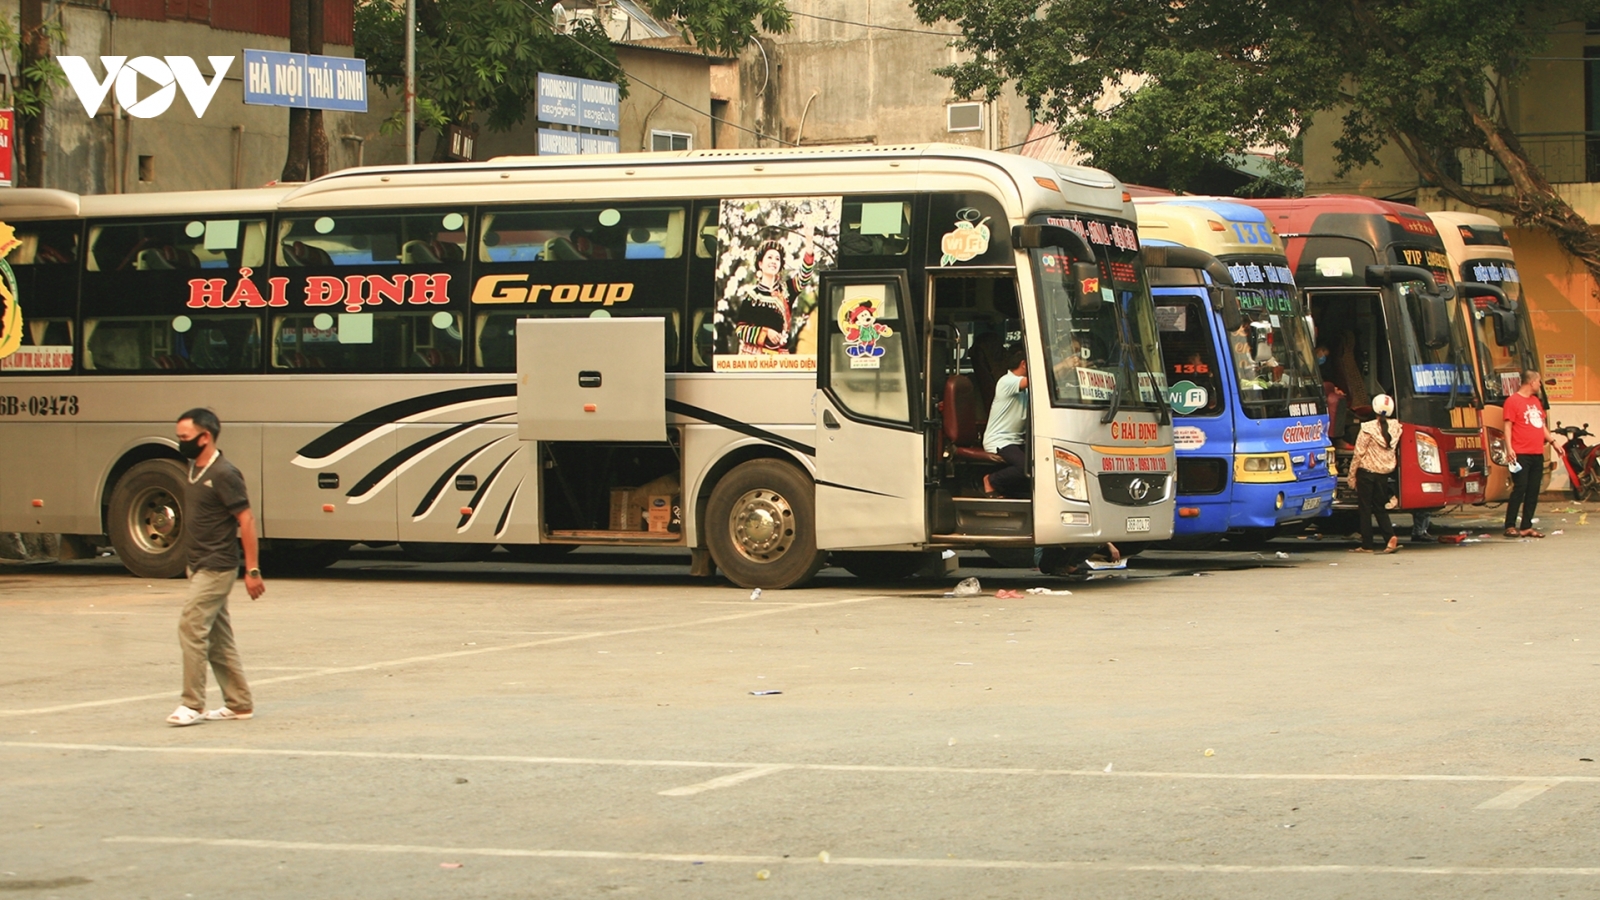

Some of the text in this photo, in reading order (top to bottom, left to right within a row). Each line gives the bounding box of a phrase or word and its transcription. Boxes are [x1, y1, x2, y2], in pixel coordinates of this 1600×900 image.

[249, 56, 302, 103] HÀ NỘI
[309, 61, 364, 101] THÁI BÌNH
[541, 78, 577, 100] PHONGSALY
[582, 84, 617, 106] OUDOMXAY
[1231, 223, 1273, 244] 136
[1402, 249, 1422, 266] VIP
[186, 267, 452, 313] HẢI ĐỊNH
[471, 273, 635, 307] Group
[1006, 330, 1021, 341] 53
[716, 360, 731, 369] HOA
[732, 360, 747, 369] BAN
[760, 355, 777, 369] KHẮP
[779, 358, 799, 369] VÙNG
[800, 358, 816, 371] ĐIỆN
[1173, 364, 1209, 374] 136
[1121, 416, 1136, 440] HẢI
[1138, 423, 1158, 445] ĐỊNH
